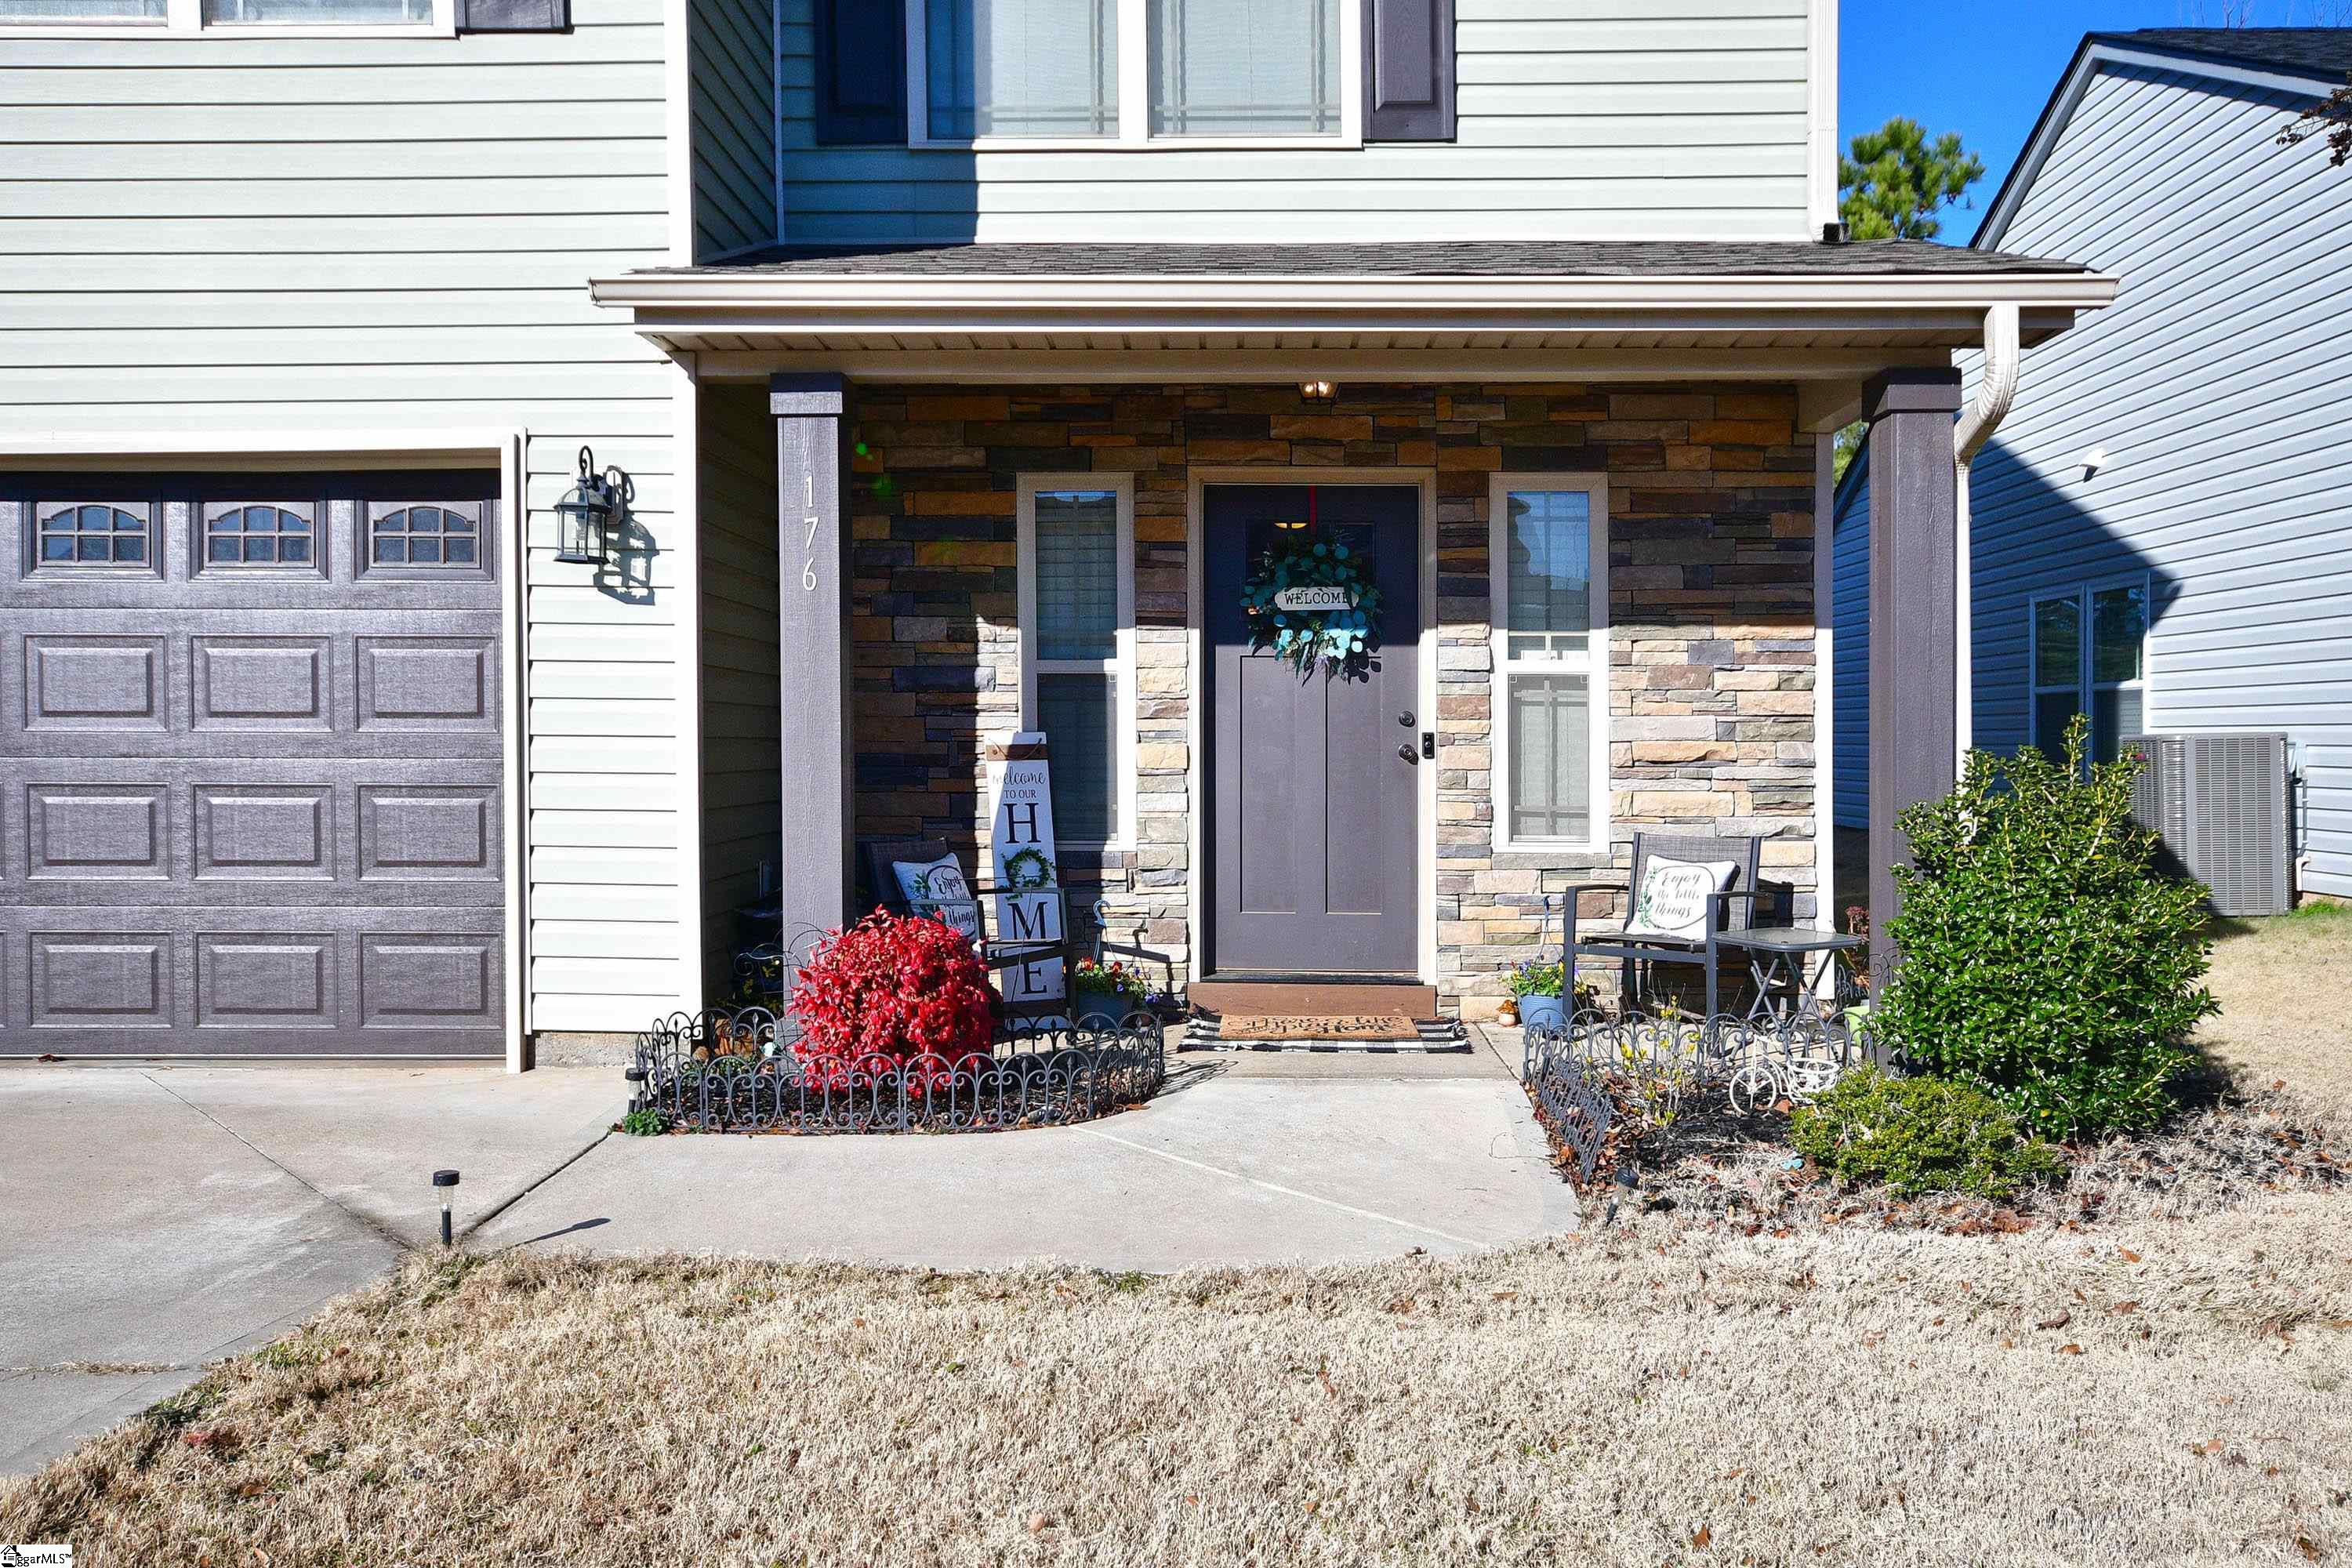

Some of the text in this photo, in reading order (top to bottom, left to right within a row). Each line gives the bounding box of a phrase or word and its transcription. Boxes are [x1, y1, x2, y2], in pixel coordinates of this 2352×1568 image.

[802, 475, 819, 592] 176
[1004, 789, 1037, 799] TO OUR
[934, 874, 963, 899] Enjoy
[1655, 902, 1692, 919] things
